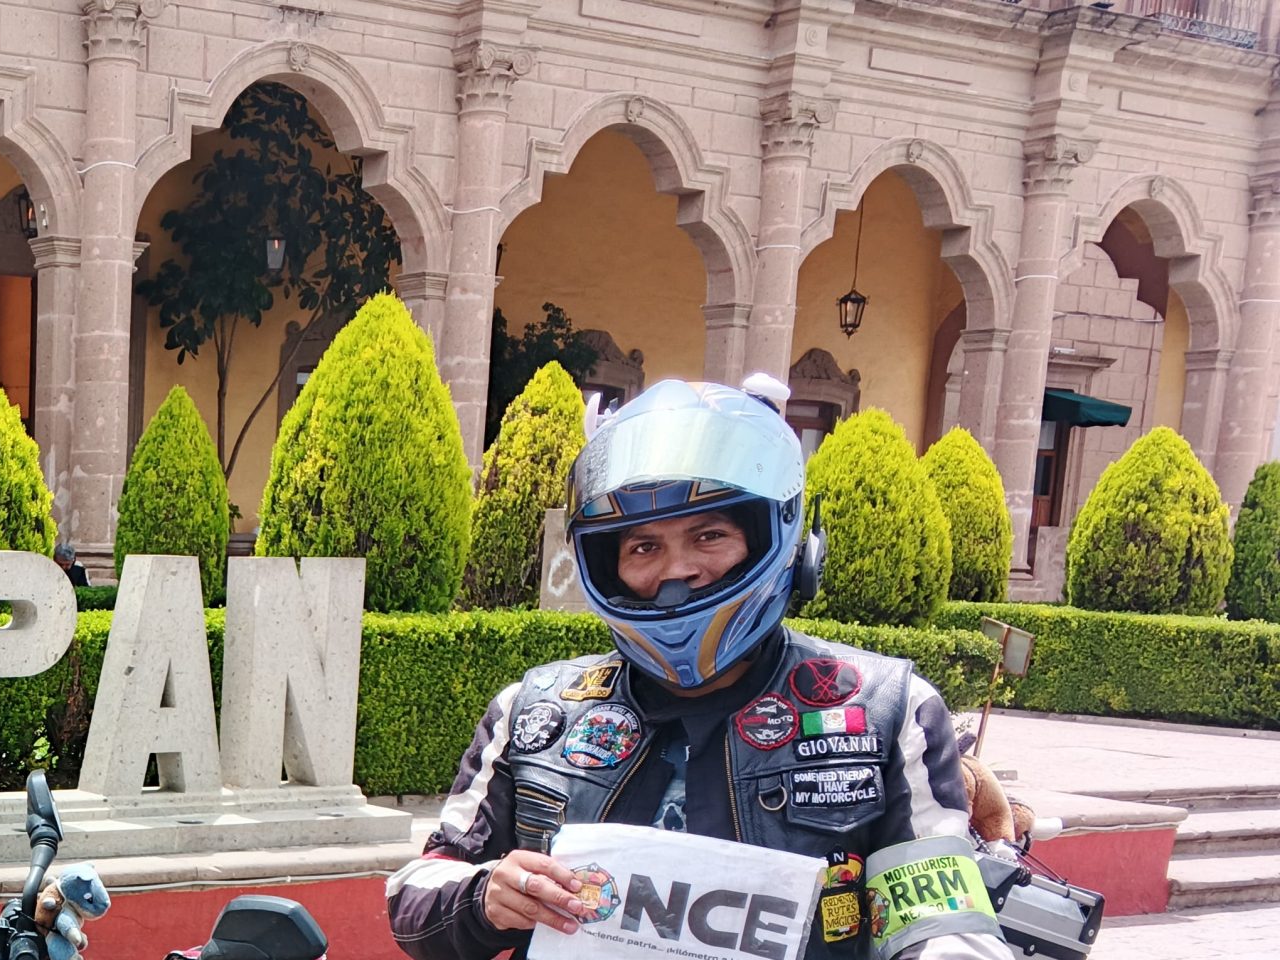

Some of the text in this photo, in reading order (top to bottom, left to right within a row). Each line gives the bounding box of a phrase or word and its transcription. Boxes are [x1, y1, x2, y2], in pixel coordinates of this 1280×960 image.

[798, 736, 877, 756] GIOVANNI
[794, 772, 817, 783] SOME
[817, 771, 837, 782] NEED
[796, 787, 876, 803] MY MOTORCYCLE
[818, 781, 850, 793] I HAVE
[833, 851, 845, 863] N
[883, 856, 959, 884] MOTOTURISTA
[888, 870, 969, 912] RRM
